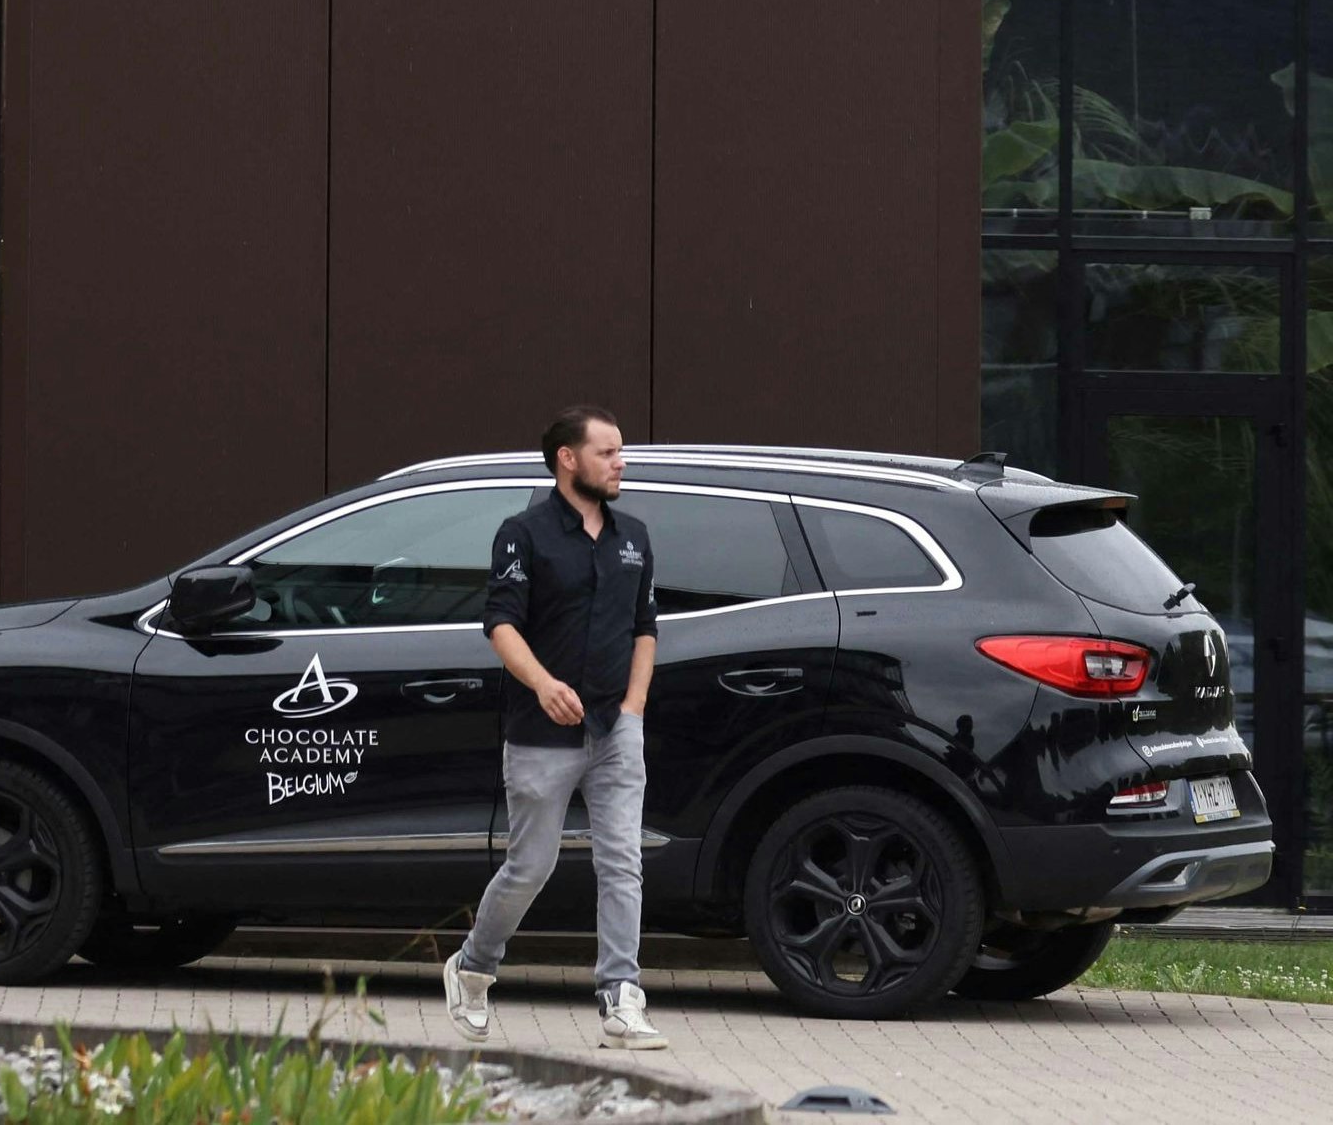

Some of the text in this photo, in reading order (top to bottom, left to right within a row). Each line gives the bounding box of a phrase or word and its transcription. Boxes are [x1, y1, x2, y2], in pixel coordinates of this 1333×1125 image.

[244, 728, 379, 746] CHOCOLATE
[259, 747, 365, 764] ACADEMY
[266, 771, 345, 805] BELGIUM
